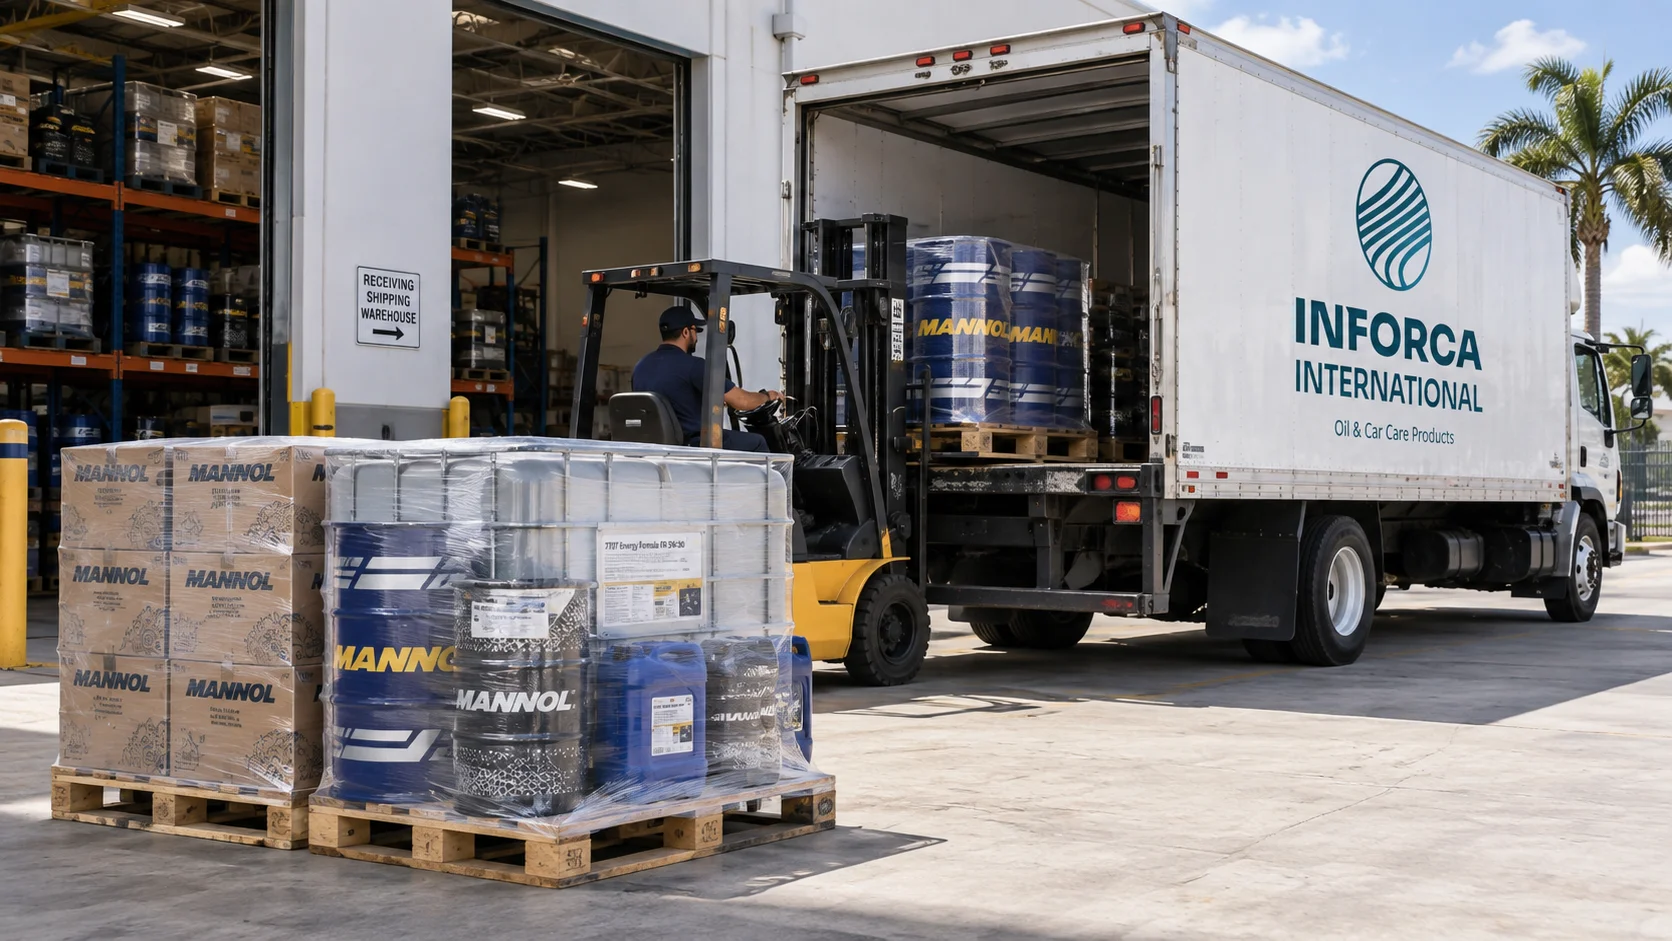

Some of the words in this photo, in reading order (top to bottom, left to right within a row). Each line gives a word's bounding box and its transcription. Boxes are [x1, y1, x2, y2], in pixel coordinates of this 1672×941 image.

[363, 274, 415, 291] RECEIVING
[366, 291, 411, 307] SHIPPING
[361, 307, 417, 325] WAREHOUSE
[918, 318, 1009, 338] MANNOL
[1295, 296, 1482, 371] INFORCA
[1295, 359, 1483, 413] INTERNATIONAL
[1334, 419, 1350, 437] Oil
[1352, 421, 1362, 438] &
[1364, 422, 1383, 439] Car
[1385, 424, 1409, 441] Care
[1412, 426, 1455, 445] Products
[74, 463, 150, 482] MANNOL
[187, 462, 275, 482] MANNOL
[73, 565, 149, 585] MANNOL
[185, 569, 274, 591] MANNOL
[74, 669, 150, 692] MANNOL
[186, 679, 275, 703] MANNOL
[456, 688, 573, 713] MANNOL
